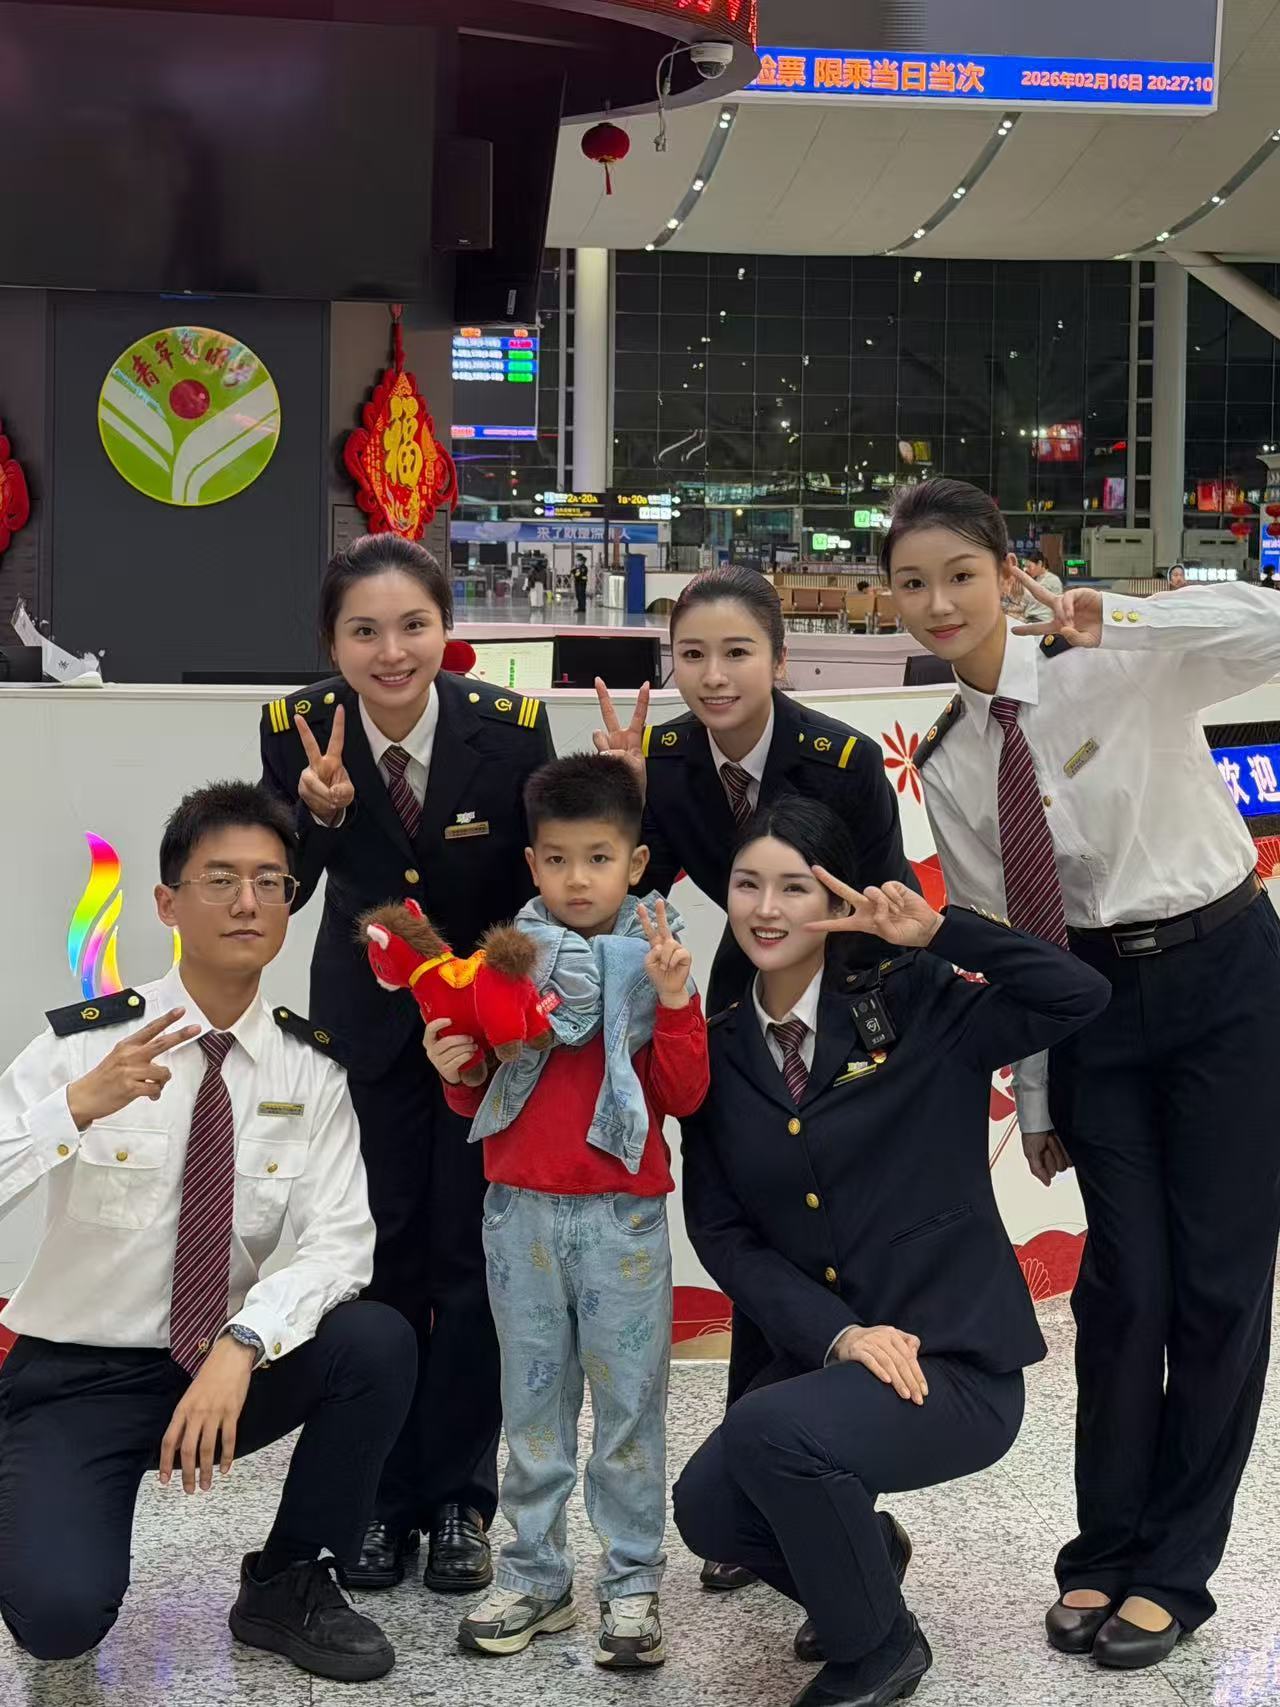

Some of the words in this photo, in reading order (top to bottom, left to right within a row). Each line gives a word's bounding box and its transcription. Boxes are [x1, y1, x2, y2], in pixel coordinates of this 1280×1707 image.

[813, 57, 985, 93] 限乘当日当次
[1021, 71, 1143, 92] 2026年02月16日
[1147, 75, 1214, 92] 20:27:10
[1216, 754, 1280, 805] 欢迎
